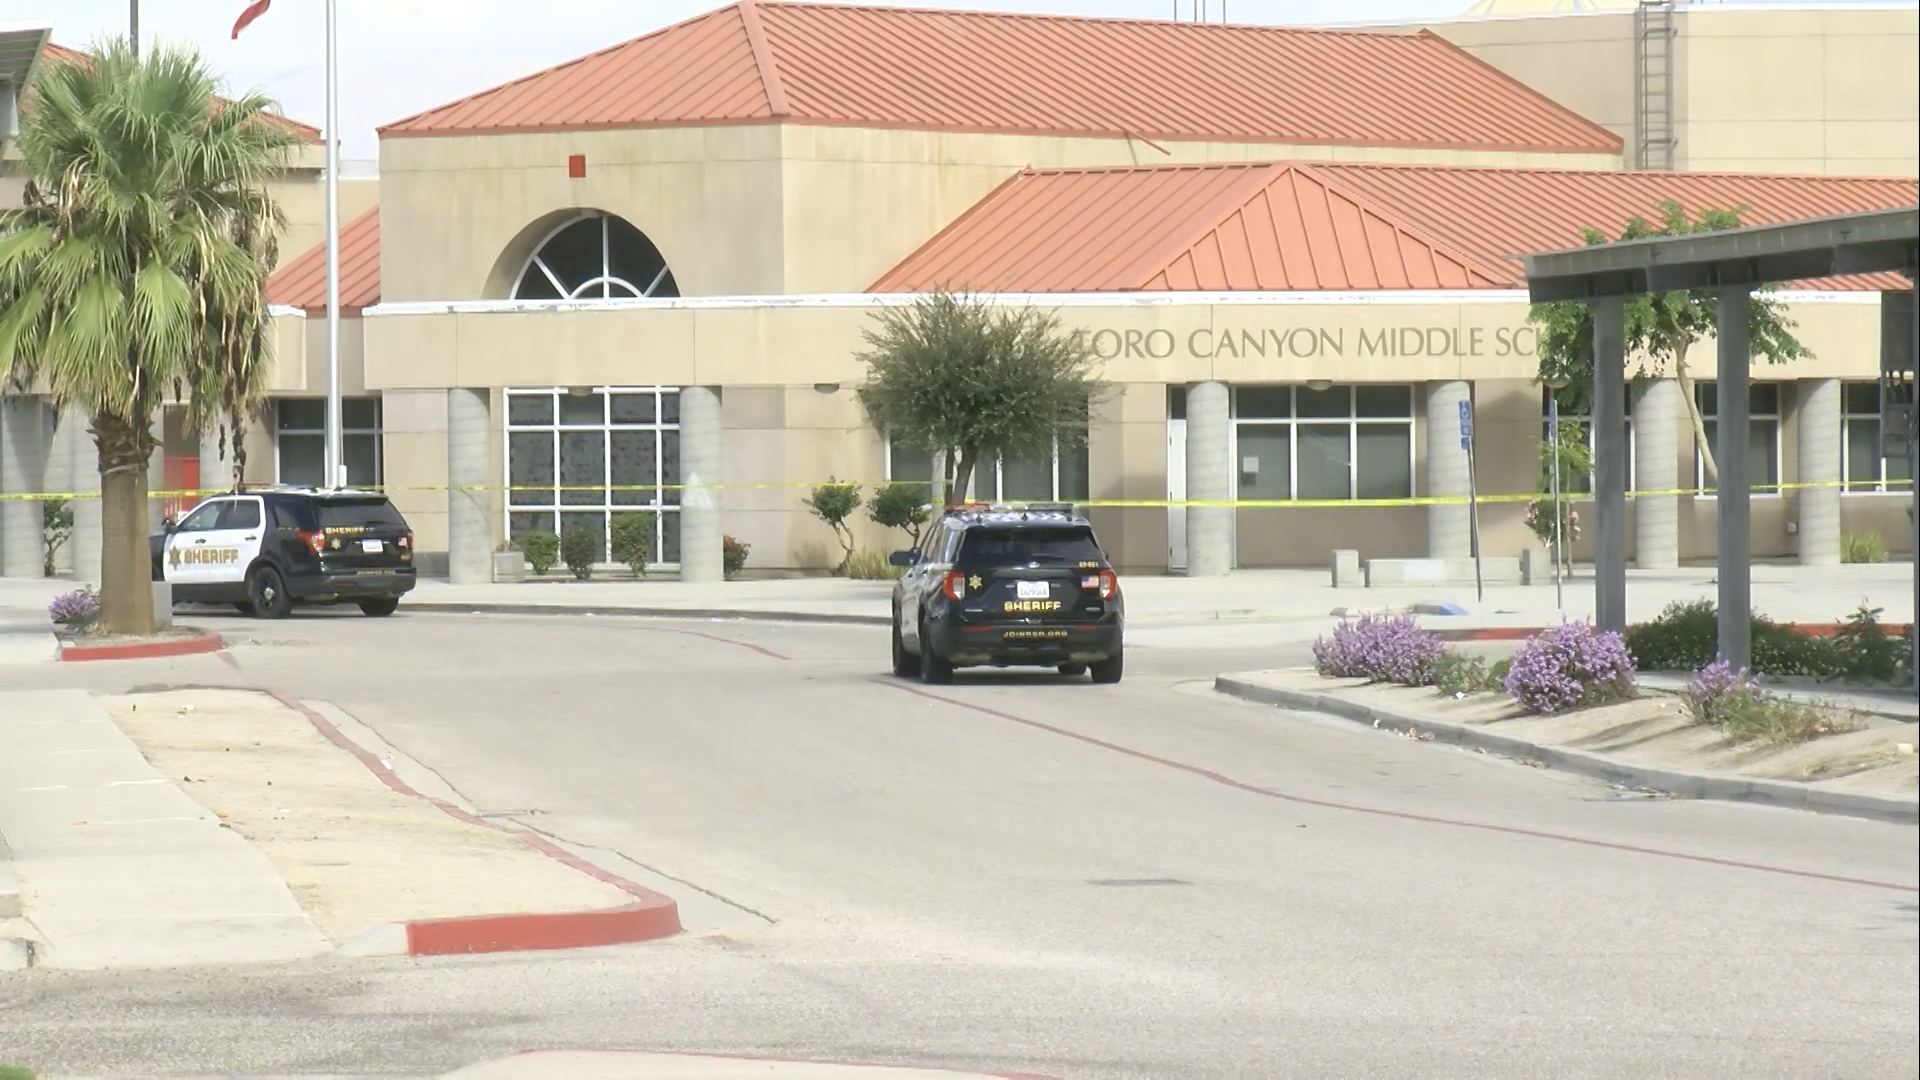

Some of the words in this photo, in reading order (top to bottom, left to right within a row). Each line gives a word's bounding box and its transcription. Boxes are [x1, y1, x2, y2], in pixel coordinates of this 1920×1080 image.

[1070, 328, 1175, 359] TORO
[1187, 327, 1344, 358] CANYON
[1357, 326, 1484, 357] MIDDLE
[325, 526, 365, 535] SHERIFF
[183, 548, 239, 564] SHERIFF
[1003, 600, 1062, 612] SHERIFF
